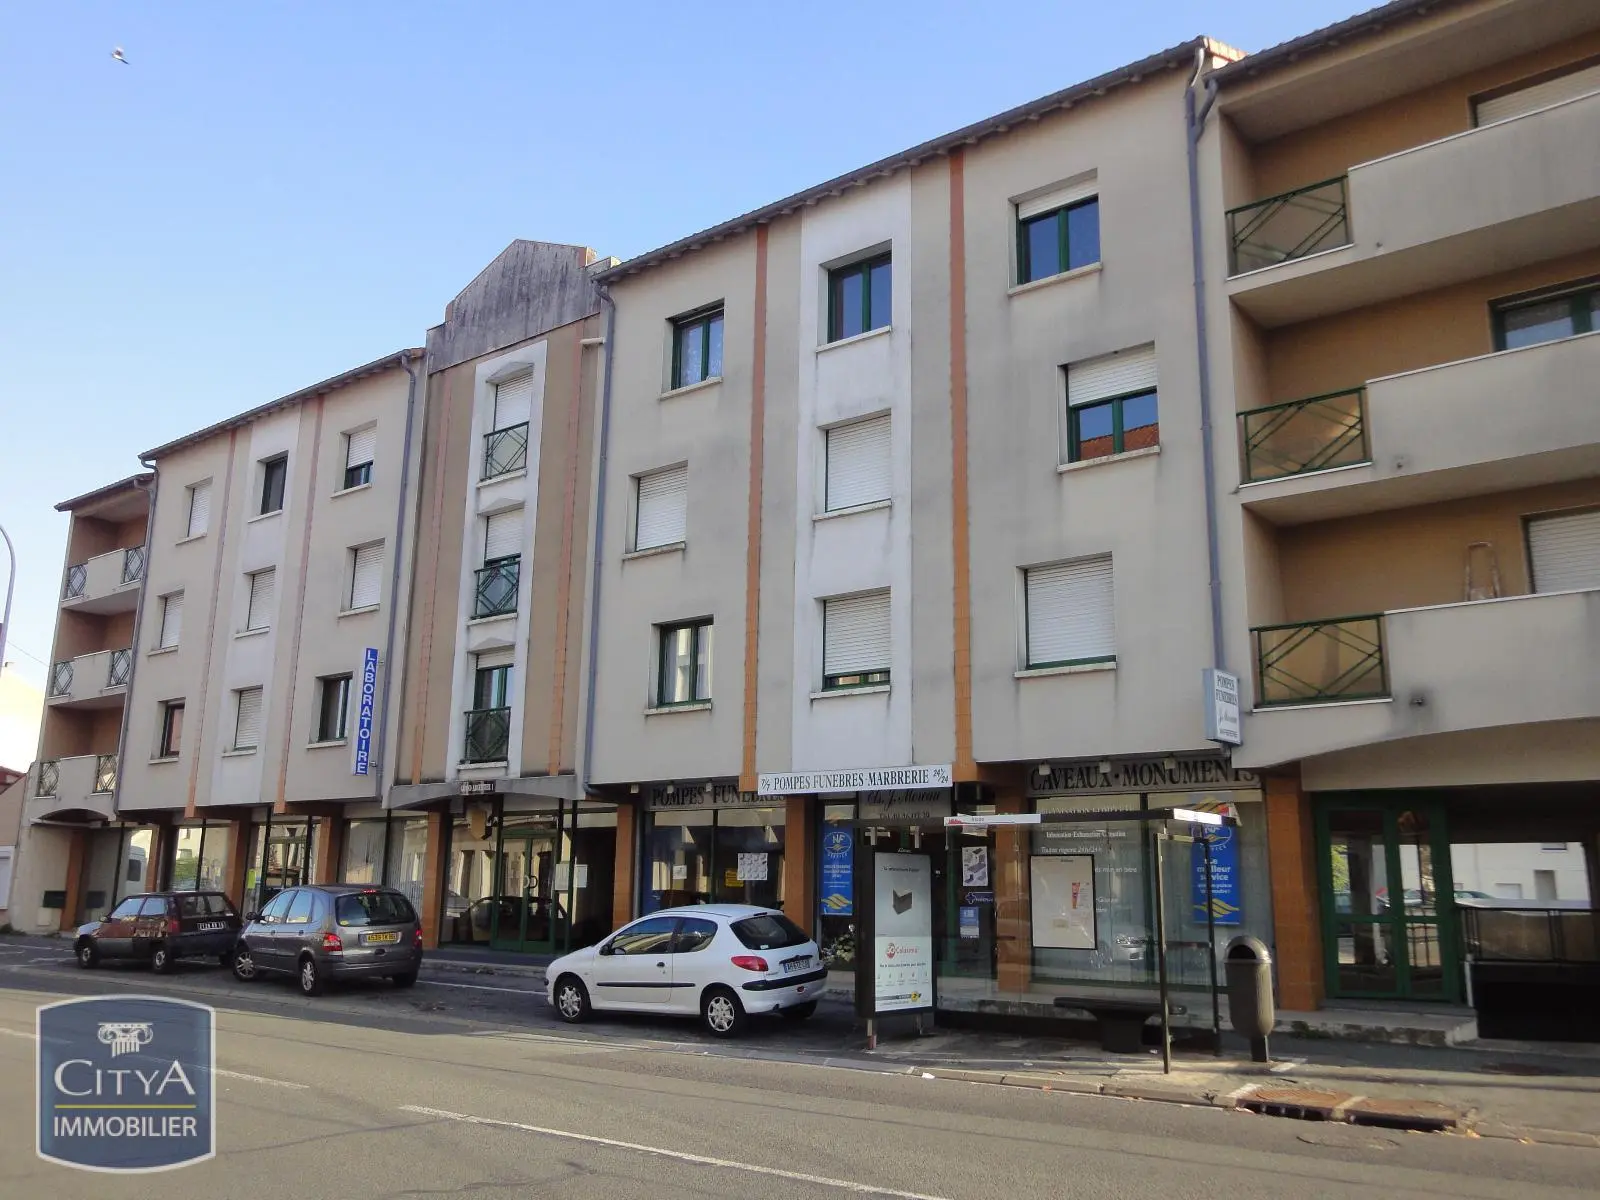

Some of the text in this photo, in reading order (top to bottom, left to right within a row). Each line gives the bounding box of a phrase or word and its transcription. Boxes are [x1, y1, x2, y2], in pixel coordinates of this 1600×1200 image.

[356, 649, 375, 773] LABORATOIRE
[774, 775, 811, 791] POMPES
[813, 772, 864, 789] FUNEBRES
[868, 769, 929, 787] MARBRERIE
[1031, 765, 1113, 791] CAVEAUX
[652, 785, 705, 806] POMPES
